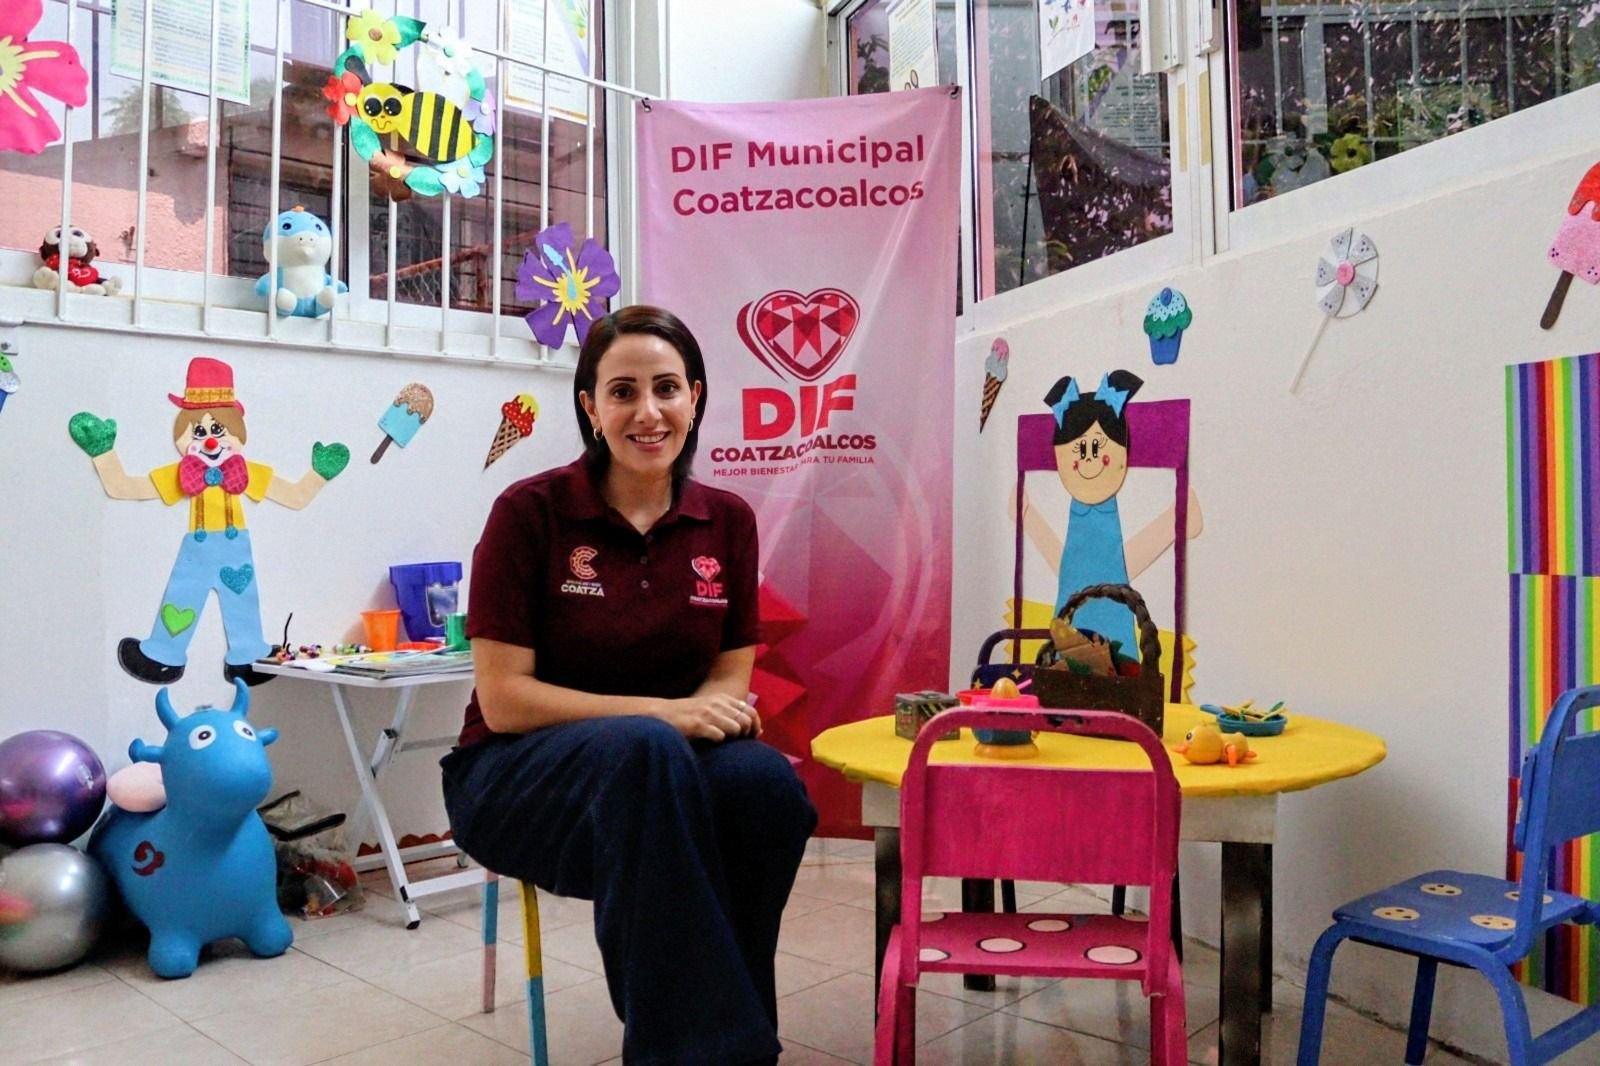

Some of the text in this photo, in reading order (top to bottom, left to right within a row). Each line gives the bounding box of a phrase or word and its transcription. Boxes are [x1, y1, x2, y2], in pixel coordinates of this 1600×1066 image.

[671, 134, 924, 173] DIF Municipal
[673, 179, 924, 216] Coatzacoalcos
[742, 374, 857, 441] DIF
[710, 434, 877, 463] COATZACOALCOS
[713, 468, 748, 477] MEJOR
[823, 455, 835, 465] TU
[837, 455, 874, 465] FAMILIA
[560, 584, 605, 597] COATZA
[696, 580, 723, 597] DIF
